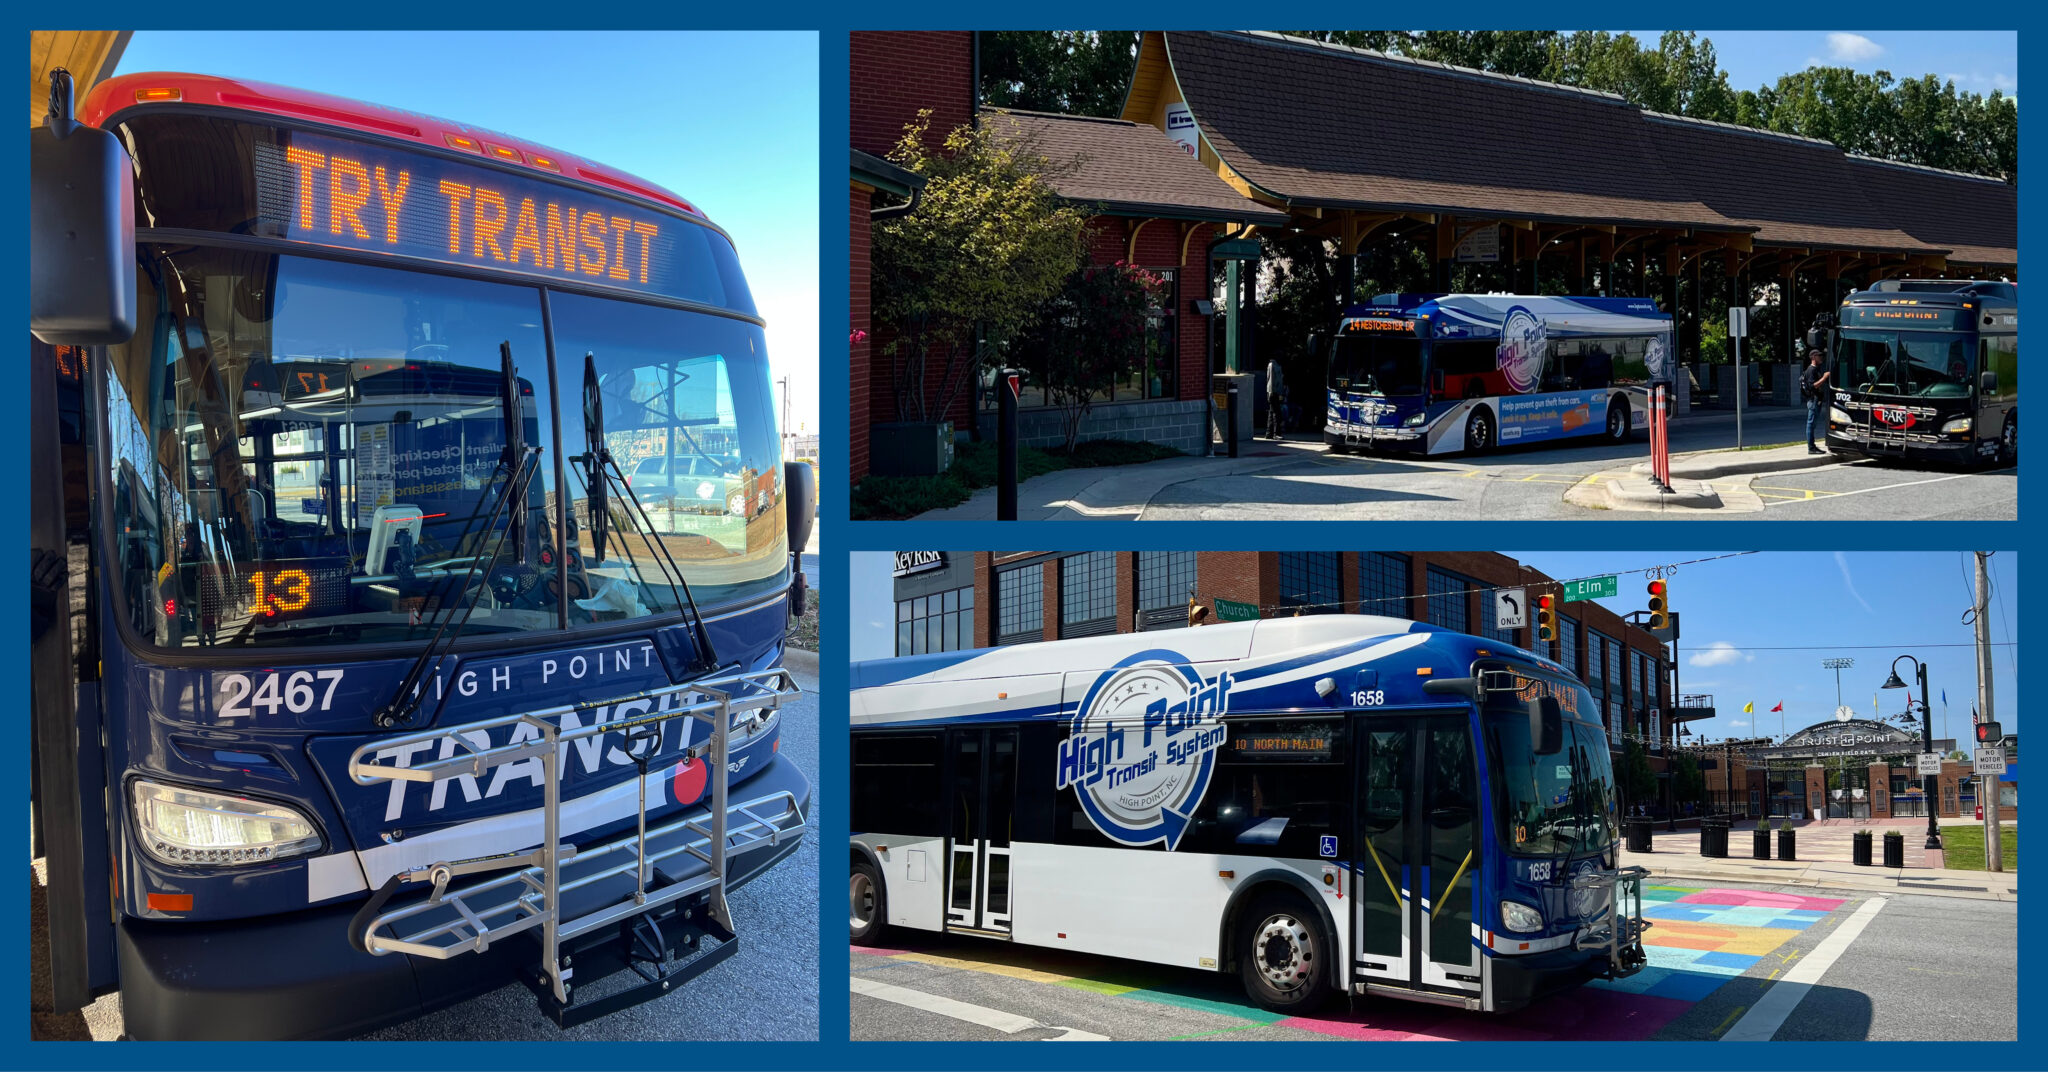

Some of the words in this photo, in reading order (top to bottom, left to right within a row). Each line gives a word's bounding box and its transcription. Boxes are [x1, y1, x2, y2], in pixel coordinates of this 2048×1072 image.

[287, 145, 409, 243] TRY
[439, 180, 658, 284] TRANSIT
[1161, 271, 1173, 281] 201
[1350, 318, 1360, 331] 14
[1361, 320, 1403, 331] WESTCHESTER
[1405, 321, 1415, 331] DR
[1497, 337, 1519, 369] High
[1523, 318, 1547, 350] Point
[1515, 400, 1534, 411] prevent
[1835, 392, 1851, 402] 1702
[895, 551, 913, 574] Key
[248, 569, 310, 613] 13
[1578, 581, 1602, 594] Elm
[1215, 600, 1250, 618] Church
[1500, 617, 1522, 626] ONLY
[542, 646, 653, 684] POINT
[218, 669, 344, 718] 2467
[1350, 690, 1384, 706] 1658
[1058, 721, 1125, 787] High
[1143, 671, 1232, 748] Point
[1235, 739, 1247, 750] 10
[1254, 739, 1288, 750] NORTH
[1292, 739, 1324, 750] MAIN
[1800, 737, 1838, 746] TRUIST
[1856, 734, 1892, 744] POINT
[376, 690, 706, 822] TRANSIT
[1106, 751, 1158, 789] Transit
[1167, 726, 1224, 766] System
[1120, 796, 1139, 806] HIGH
[1141, 789, 1167, 806] POINT,
[1166, 776, 1177, 790] NC
[1515, 825, 1526, 843] 10
[1528, 862, 1551, 881] 1658
